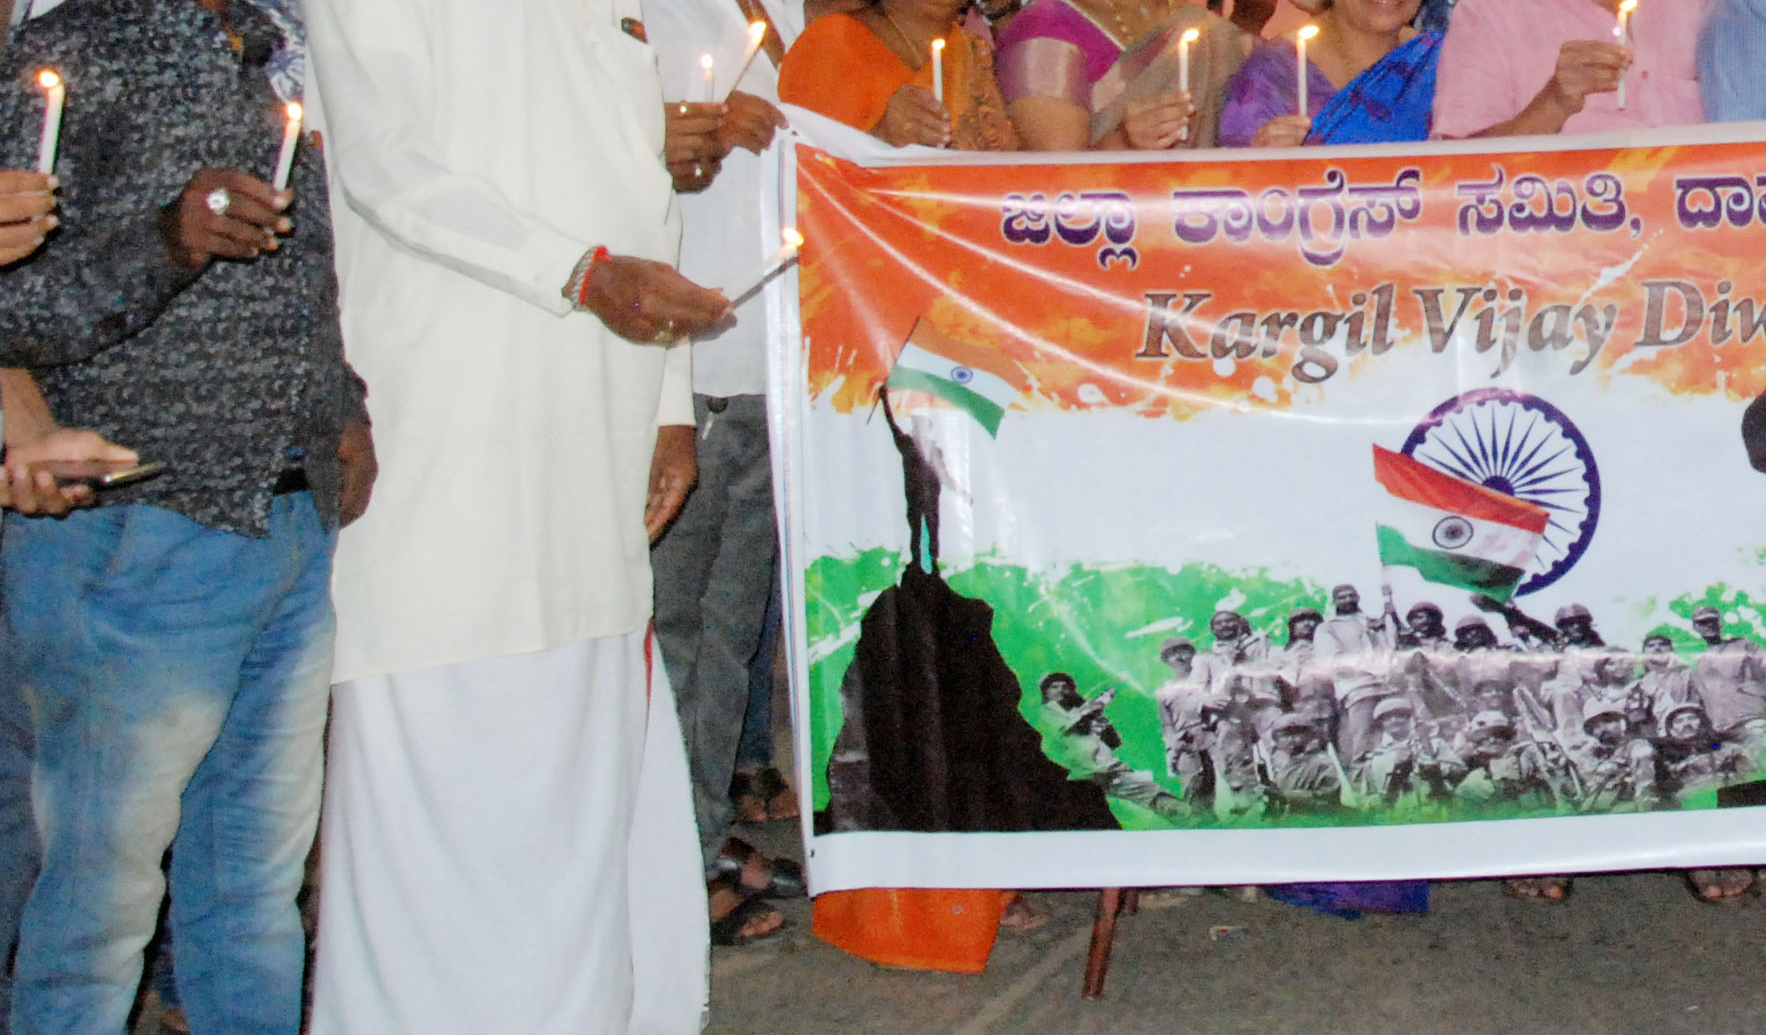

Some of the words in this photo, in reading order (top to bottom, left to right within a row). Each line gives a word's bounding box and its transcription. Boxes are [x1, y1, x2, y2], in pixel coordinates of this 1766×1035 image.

[1002, 192, 1138, 270] ಜಿಲ್ಲಾ
[1172, 168, 1422, 266] ಕಾಂಗ್ರೆಸ್
[1456, 164, 1643, 239] ಸಮಿತಿ,
[1134, 283, 1396, 385] Kargil
[1412, 283, 1618, 378] Vijay
